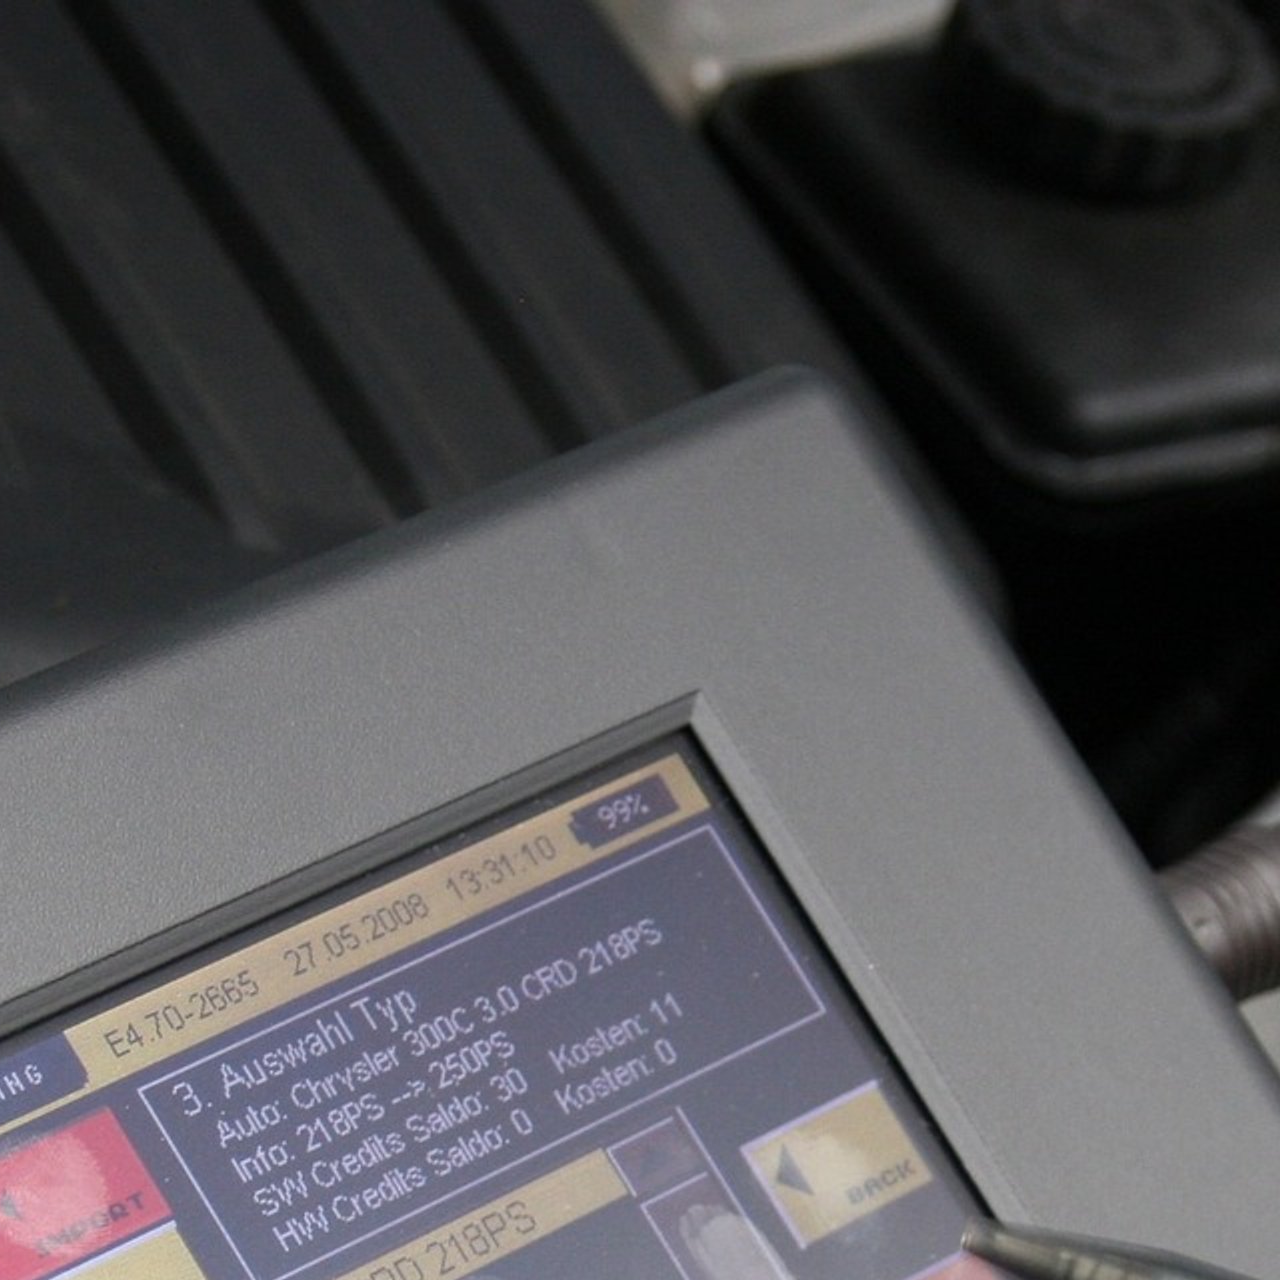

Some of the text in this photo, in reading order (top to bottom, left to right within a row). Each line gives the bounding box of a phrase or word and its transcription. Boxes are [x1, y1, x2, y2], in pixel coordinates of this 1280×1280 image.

[593, 789, 652, 831] 99%
[101, 834, 561, 1059] E4.70-2665 27.05.2008 13:31:10
[168, 980, 425, 1118] 3. Auswahl Typ
[207, 915, 668, 1150] Auto: Chrysler 300C 3.0 CRD 218PS
[228, 1134, 298, 1185] Info:
[290, 1090, 389, 1154] 218PS
[424, 1027, 520, 1090] 250PS
[248, 991, 685, 1219] SW Credits Saldo: 30 Kosten: 11
[29, 1190, 151, 1259] IMPORT
[269, 1204, 336, 1253] HW
[325, 1158, 431, 1225] Credits
[422, 1118, 513, 1179] Saldo:
[551, 1050, 657, 1116] Kosten:
[841, 1157, 919, 1207] BACK
[421, 1197, 541, 1276] 218PS
